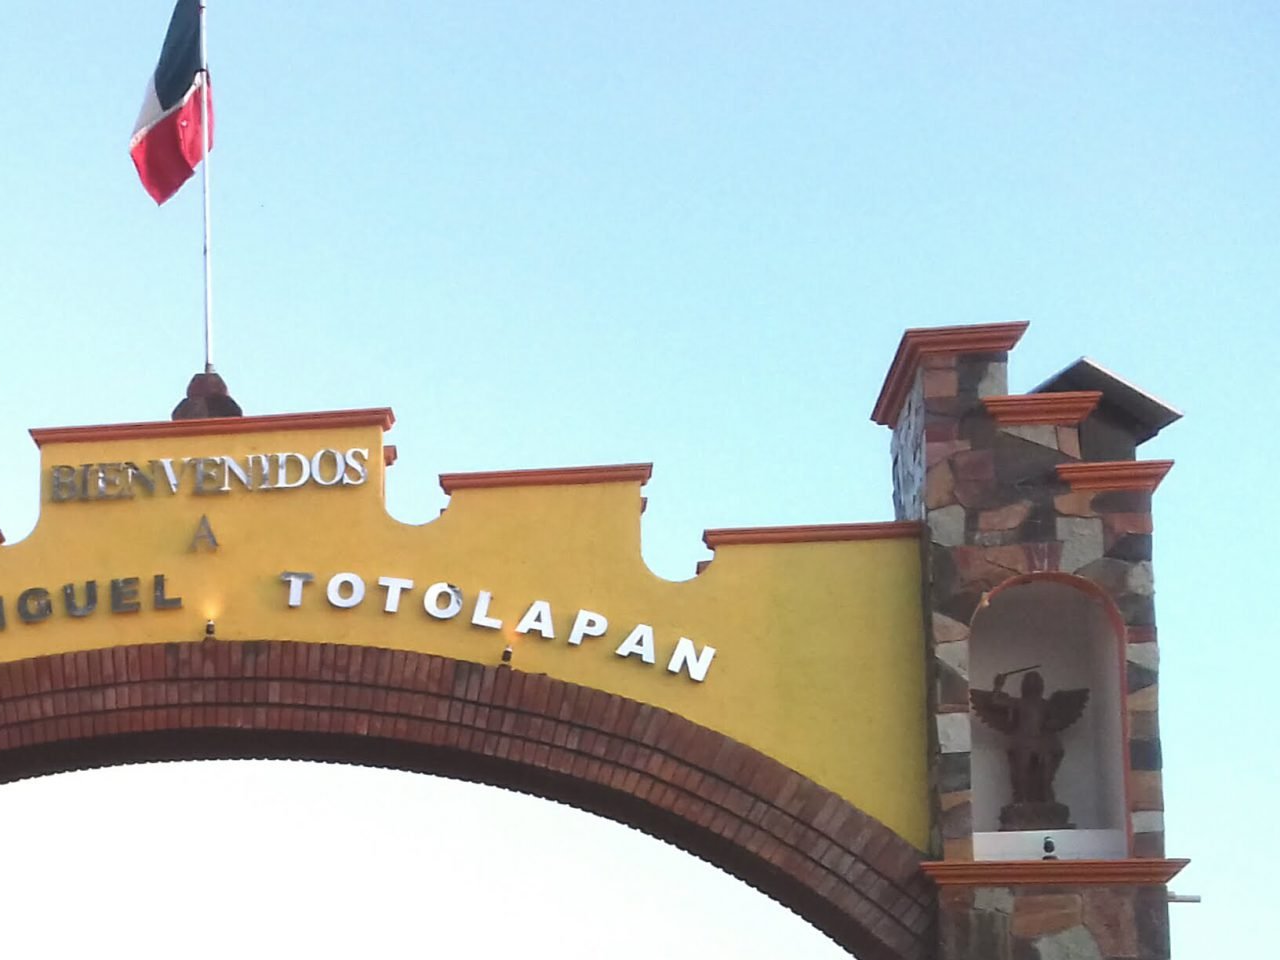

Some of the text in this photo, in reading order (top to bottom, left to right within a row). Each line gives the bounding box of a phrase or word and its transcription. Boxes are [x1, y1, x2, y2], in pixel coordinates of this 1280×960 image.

[51, 448, 369, 502] BIENVENIDOS
[191, 513, 219, 552] A
[280, 570, 717, 683] TOTOLAPAN
